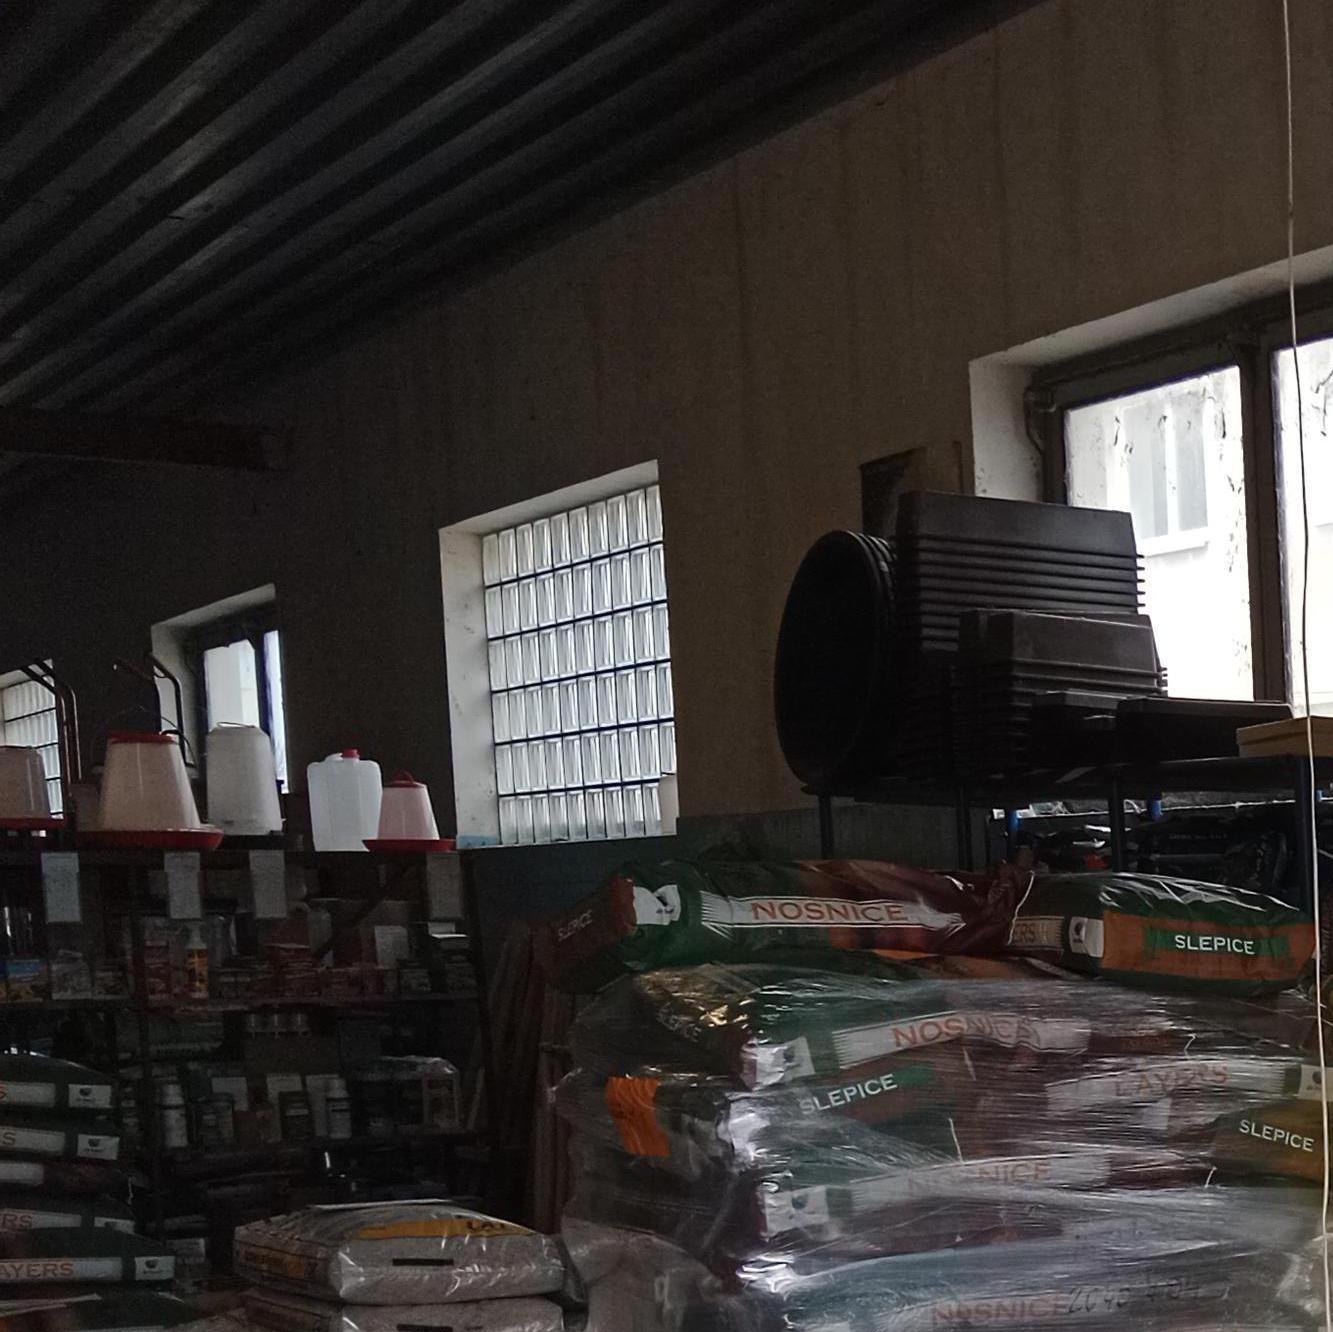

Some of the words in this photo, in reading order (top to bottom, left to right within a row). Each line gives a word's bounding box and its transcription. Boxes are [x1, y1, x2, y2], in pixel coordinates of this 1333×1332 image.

[750, 901, 909, 924] NOSNICE
[1175, 934, 1256, 955] SLEPICE
[799, 1073, 899, 1115] SLEPICE
[1238, 1118, 1315, 1153] SLEPICE
